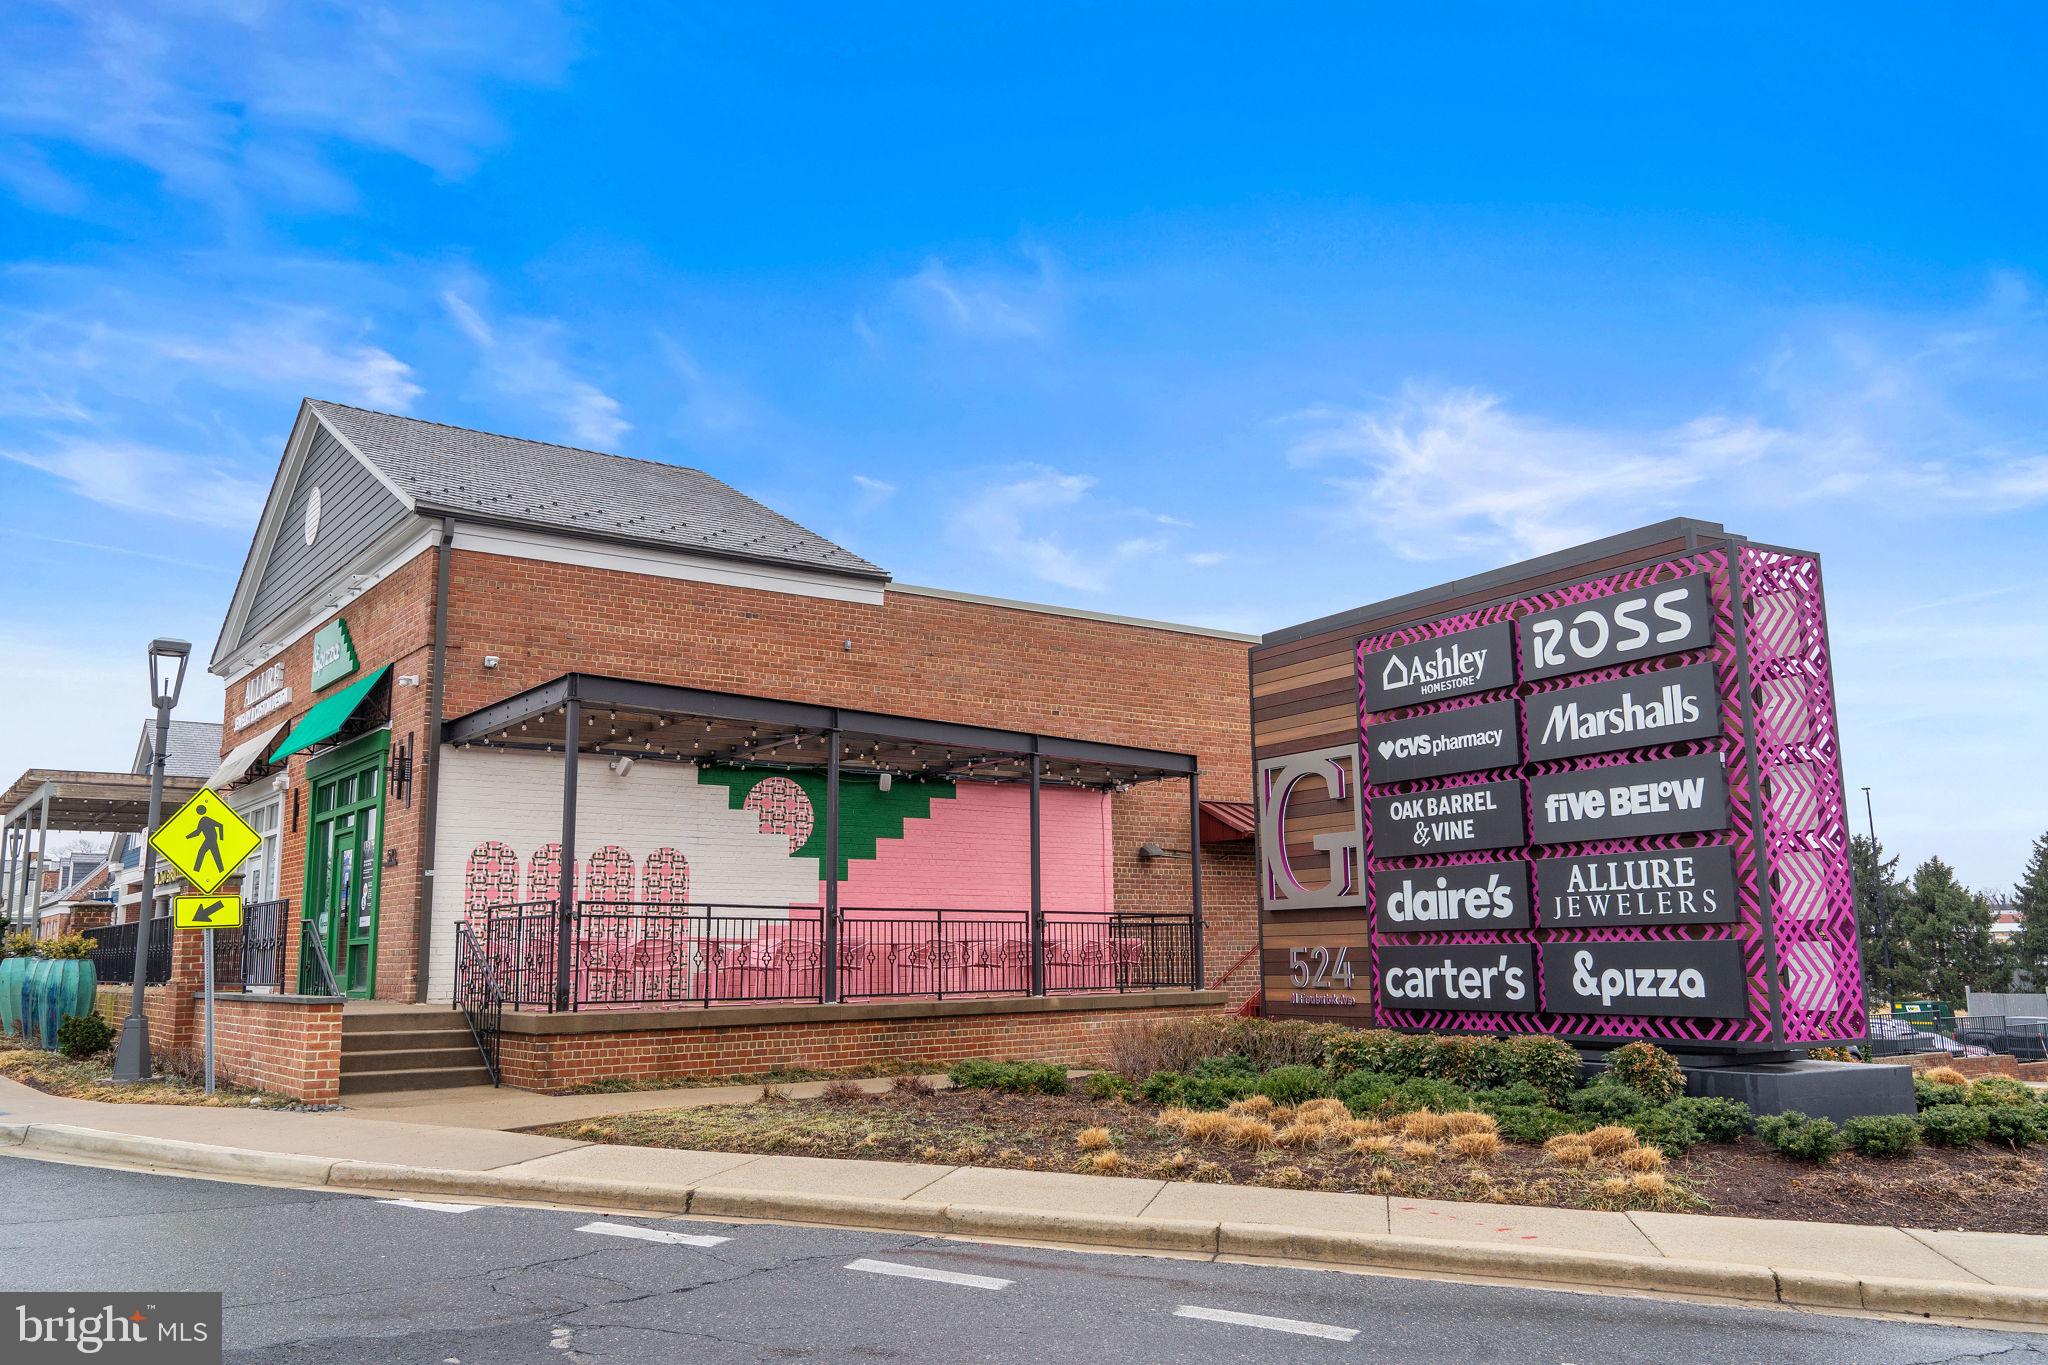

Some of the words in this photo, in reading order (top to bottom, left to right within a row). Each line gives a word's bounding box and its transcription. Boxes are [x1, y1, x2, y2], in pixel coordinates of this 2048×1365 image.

[1532, 588, 1692, 669] ROSS
[244, 661, 285, 708] ALLURE
[1409, 644, 1487, 686] Ashley
[1421, 676, 1475, 695] HOMESTORE
[1541, 684, 1699, 745] Marshalls
[1394, 734, 1432, 758] CVS
[1432, 729, 1503, 756] pharmacy
[1390, 799, 1425, 821] OAK
[1427, 790, 1497, 817] BARREL
[1544, 789, 1606, 822] five
[1609, 777, 1705, 817] BELOW
[1566, 857, 1696, 893] ALLURE
[1386, 873, 1514, 922] claire's
[1553, 889, 1717, 920] JEWELERS
[1290, 946, 1354, 988] 524
[1385, 955, 1526, 1000] carter's
[1572, 950, 1706, 1007] &pizza
